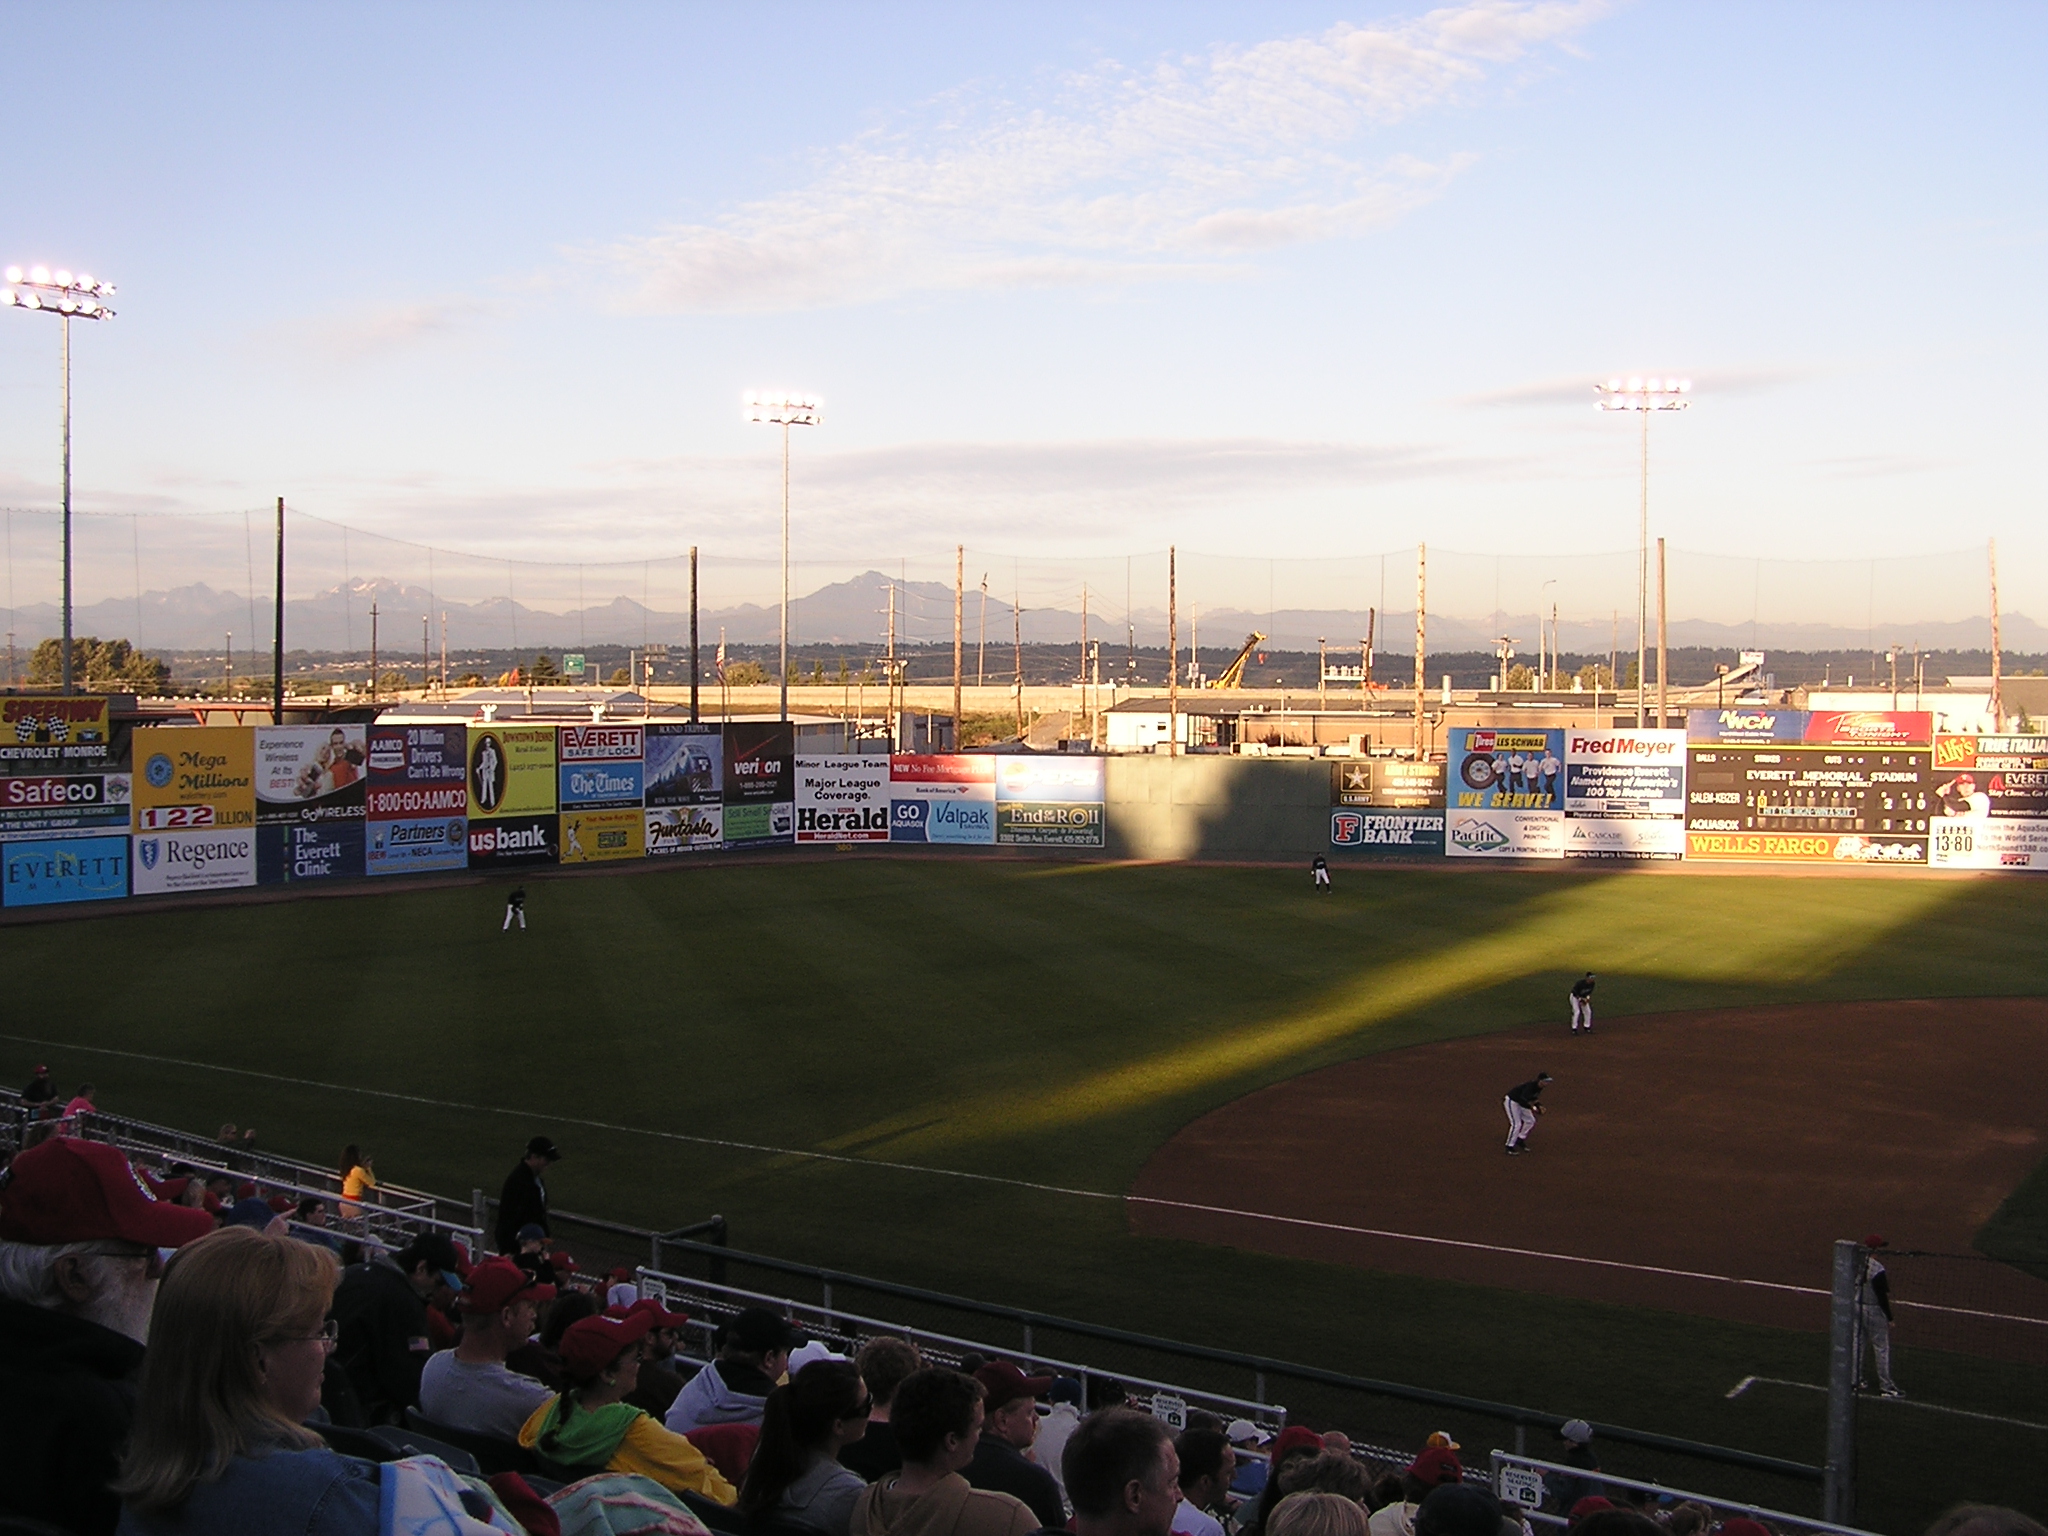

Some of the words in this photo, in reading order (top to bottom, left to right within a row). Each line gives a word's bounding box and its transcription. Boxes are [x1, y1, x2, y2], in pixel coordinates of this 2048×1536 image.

[2, 699, 108, 722] SPEEDWAY
[370, 739, 403, 751] AAMCO
[407, 729, 418, 746] 20
[563, 726, 638, 749] EVERETT
[1496, 738, 1510, 747] LES
[1510, 738, 1544, 747] SCHWAB
[0, 747, 60, 759] CHEVROLET
[63, 745, 108, 757] MONROE
[259, 739, 304, 752] Experience
[568, 748, 594, 757] SAFE
[608, 747, 636, 756] LOCK
[1936, 736, 1974, 765] Alfy's
[1977, 738, 2009, 752] TRUE
[2009, 738, 2048, 753] ITALIA
[179, 751, 228, 771] Mega
[265, 753, 299, 763] Wireless
[411, 748, 443, 764] Drivers
[271, 765, 283, 776] At
[407, 766, 430, 779] Can't
[430, 765, 441, 778] Be
[442, 766, 466, 780] Wrong
[733, 757, 782, 777] verizon
[795, 760, 820, 769] Minor
[824, 760, 860, 771] League
[893, 764, 909, 773] NEW
[911, 765, 922, 773] No
[922, 764, 935, 773] Fee
[1408, 765, 1440, 777] STRONG
[1582, 766, 1634, 777] Providence
[178, 774, 249, 790] Millions
[570, 772, 595, 796] The
[595, 771, 635, 793] Times
[1570, 776, 1604, 787] Named
[1603, 778, 1622, 787] one
[1622, 777, 1634, 788] of
[1746, 770, 1796, 780] EVERETT
[1802, 771, 1864, 782] MEMORIAL
[1869, 772, 1918, 782] STADIUM
[8, 779, 97, 804] Safeco
[805, 778, 837, 791] Major
[839, 778, 881, 791] League
[814, 792, 871, 803] Coverage.
[1458, 792, 1484, 807] WE
[1490, 792, 1553, 809] SERVE!
[1585, 787, 1604, 797] 100
[1605, 788, 1621, 799] Top
[367, 789, 467, 813] 1-800-GO-AAMCO
[1746, 796, 1754, 807] 2
[1884, 798, 1893, 810] 2
[1916, 799, 1926, 810] 0
[215, 811, 253, 825] ILLION
[797, 807, 889, 831] Herald
[896, 804, 920, 819] GO
[936, 801, 989, 829] Valpak
[1010, 808, 1044, 823] End
[6, 821, 21, 829] THE
[22, 819, 48, 828] UNITY
[891, 820, 924, 828] AQUASOX
[1335, 816, 1359, 841] F
[1363, 815, 1444, 831] FRONTIER
[1689, 819, 1740, 830] AQUASOX
[1883, 819, 1891, 830] 1
[1904, 819, 1913, 831] 2
[1916, 819, 1926, 831] 0
[293, 827, 318, 843] The
[390, 824, 445, 841] Partners
[1363, 830, 1414, 844] BANK
[1451, 829, 1496, 841] Pacific
[296, 843, 341, 861] Everett
[411, 848, 433, 857] NECA
[1689, 836, 1761, 853] WELLS
[1764, 838, 1829, 855] FARGO
[166, 840, 249, 870] Regence
[8, 857, 123, 884] EVERETT
[294, 860, 332, 876] Clinic
[1505, 1470, 1538, 1482] RESERVED
